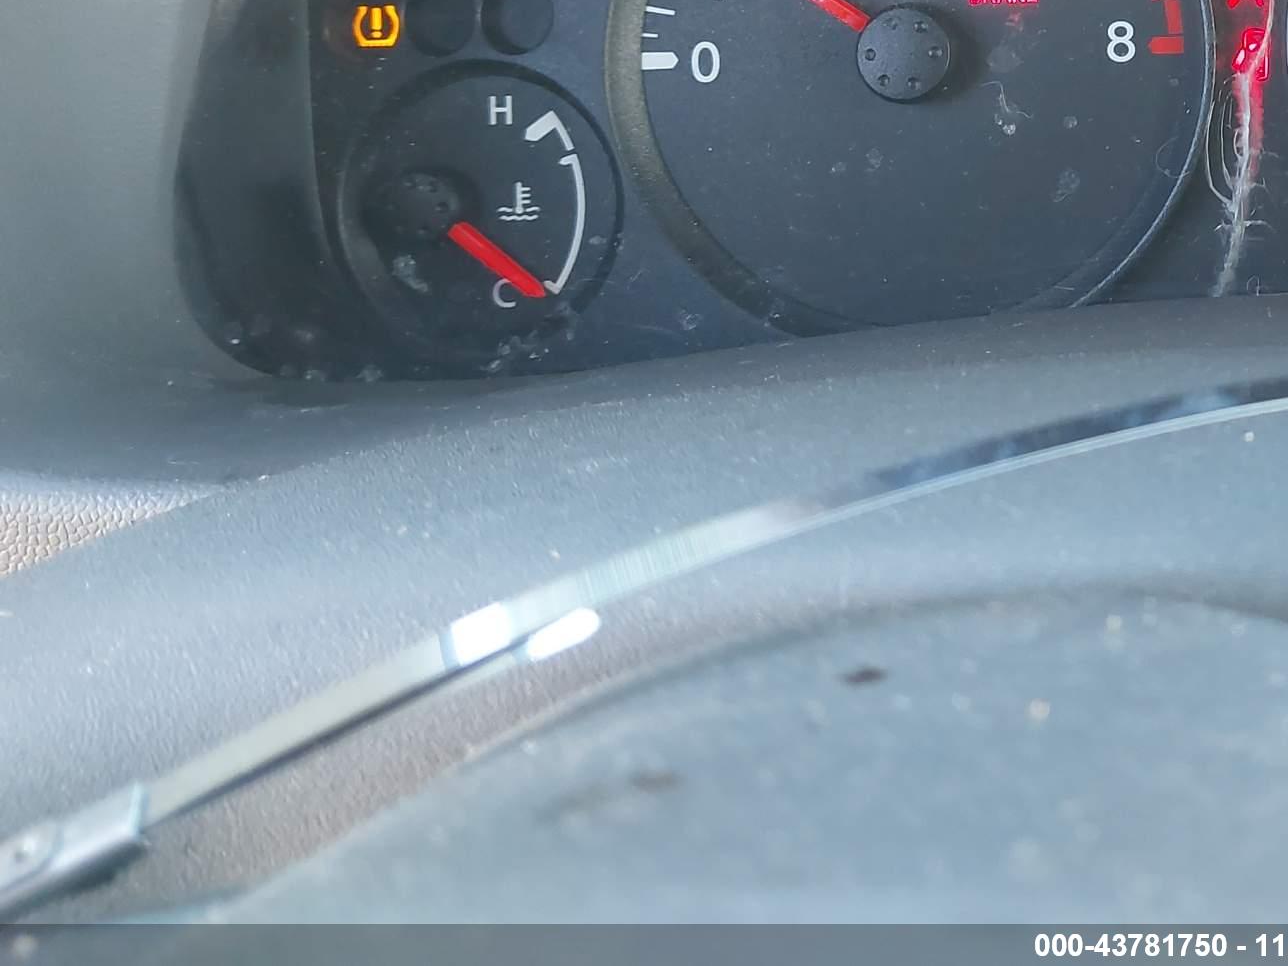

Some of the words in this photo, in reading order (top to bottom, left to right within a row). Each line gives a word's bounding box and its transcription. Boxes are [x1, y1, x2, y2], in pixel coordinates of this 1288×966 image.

[1106, 20, 1136, 63] 8
[691, 41, 720, 83] 0
[489, 95, 513, 126] H
[492, 277, 517, 308] C
